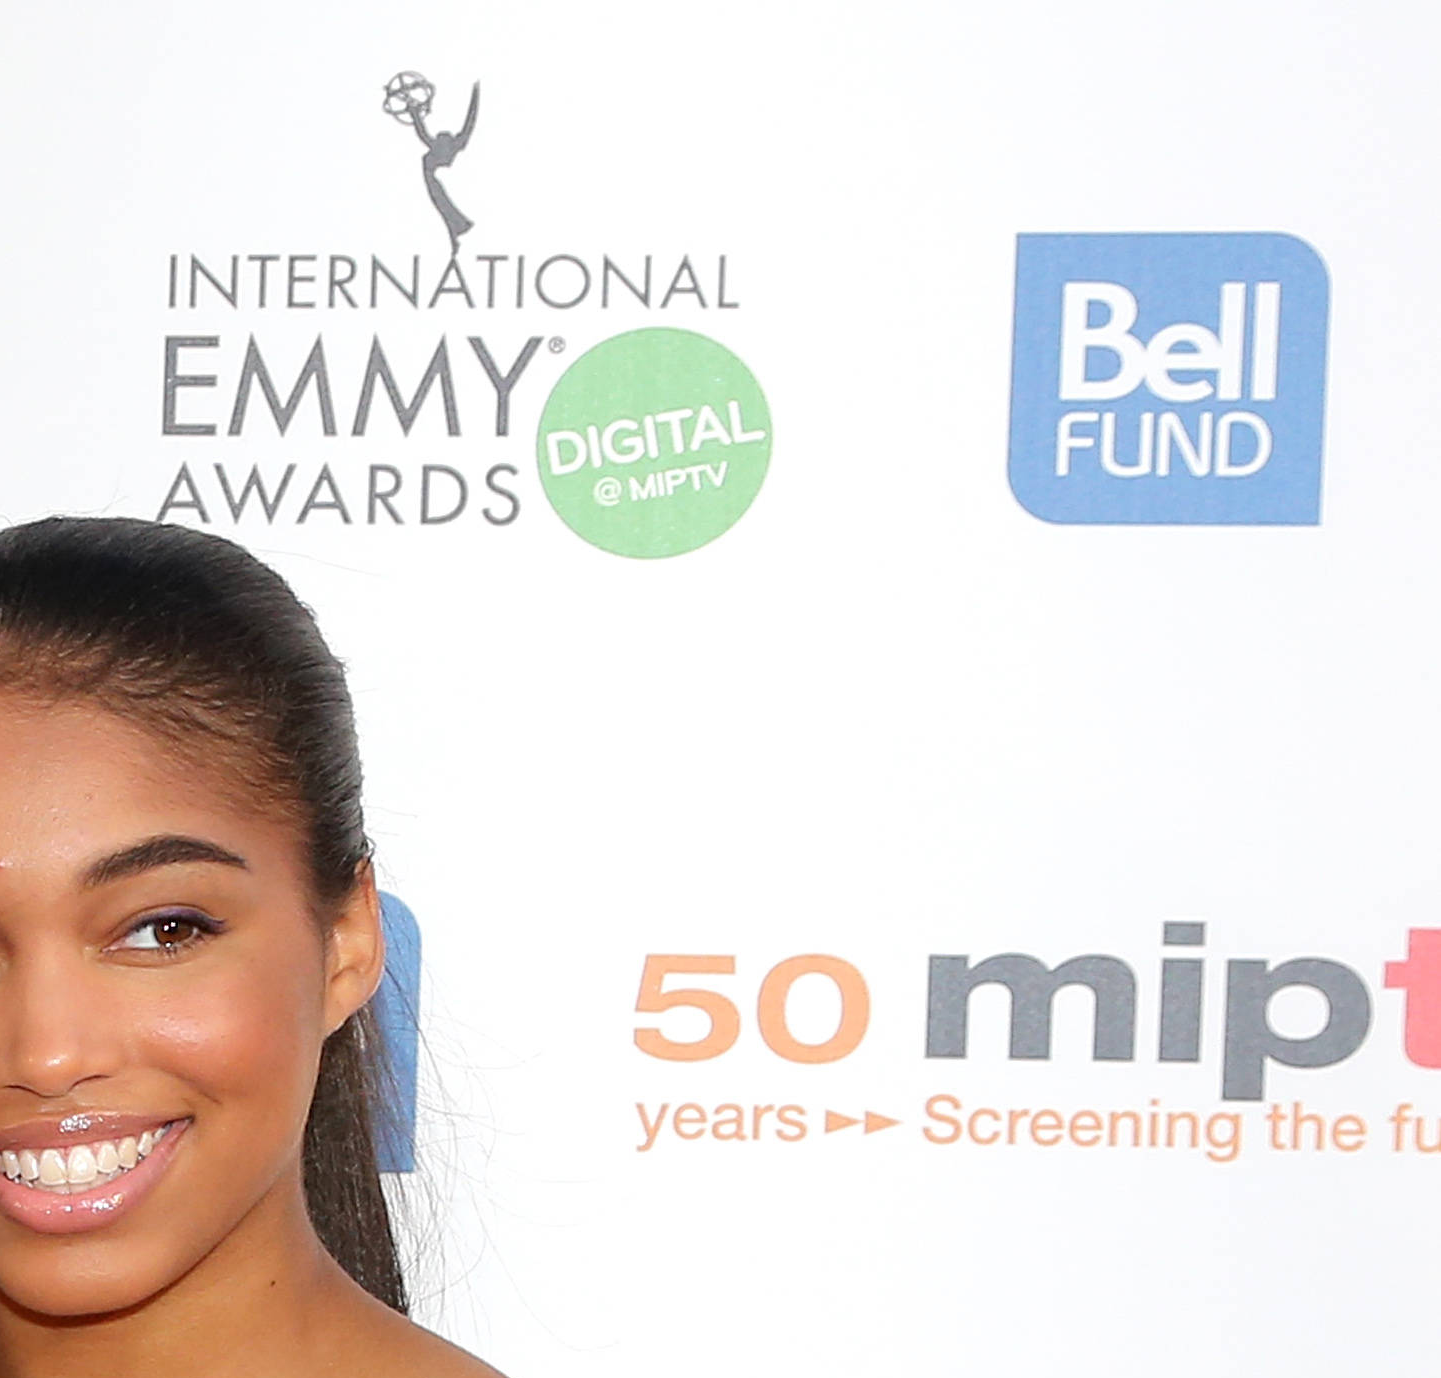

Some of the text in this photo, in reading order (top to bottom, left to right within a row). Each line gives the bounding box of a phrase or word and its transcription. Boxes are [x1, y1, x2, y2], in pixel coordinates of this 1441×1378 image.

[168, 255, 739, 310] INTERNATIONAL
[1058, 281, 1281, 402] Bell
[546, 400, 766, 476] DIGITAL
[1056, 411, 1272, 477] FUND
[157, 462, 520, 526] AWARDS
[628, 461, 728, 501] MIPTV
[633, 920, 1441, 1101] 50 mipt
[636, 1103, 808, 1153] years
[922, 1098, 1243, 1163] Screening
[1265, 1100, 1368, 1153] the
